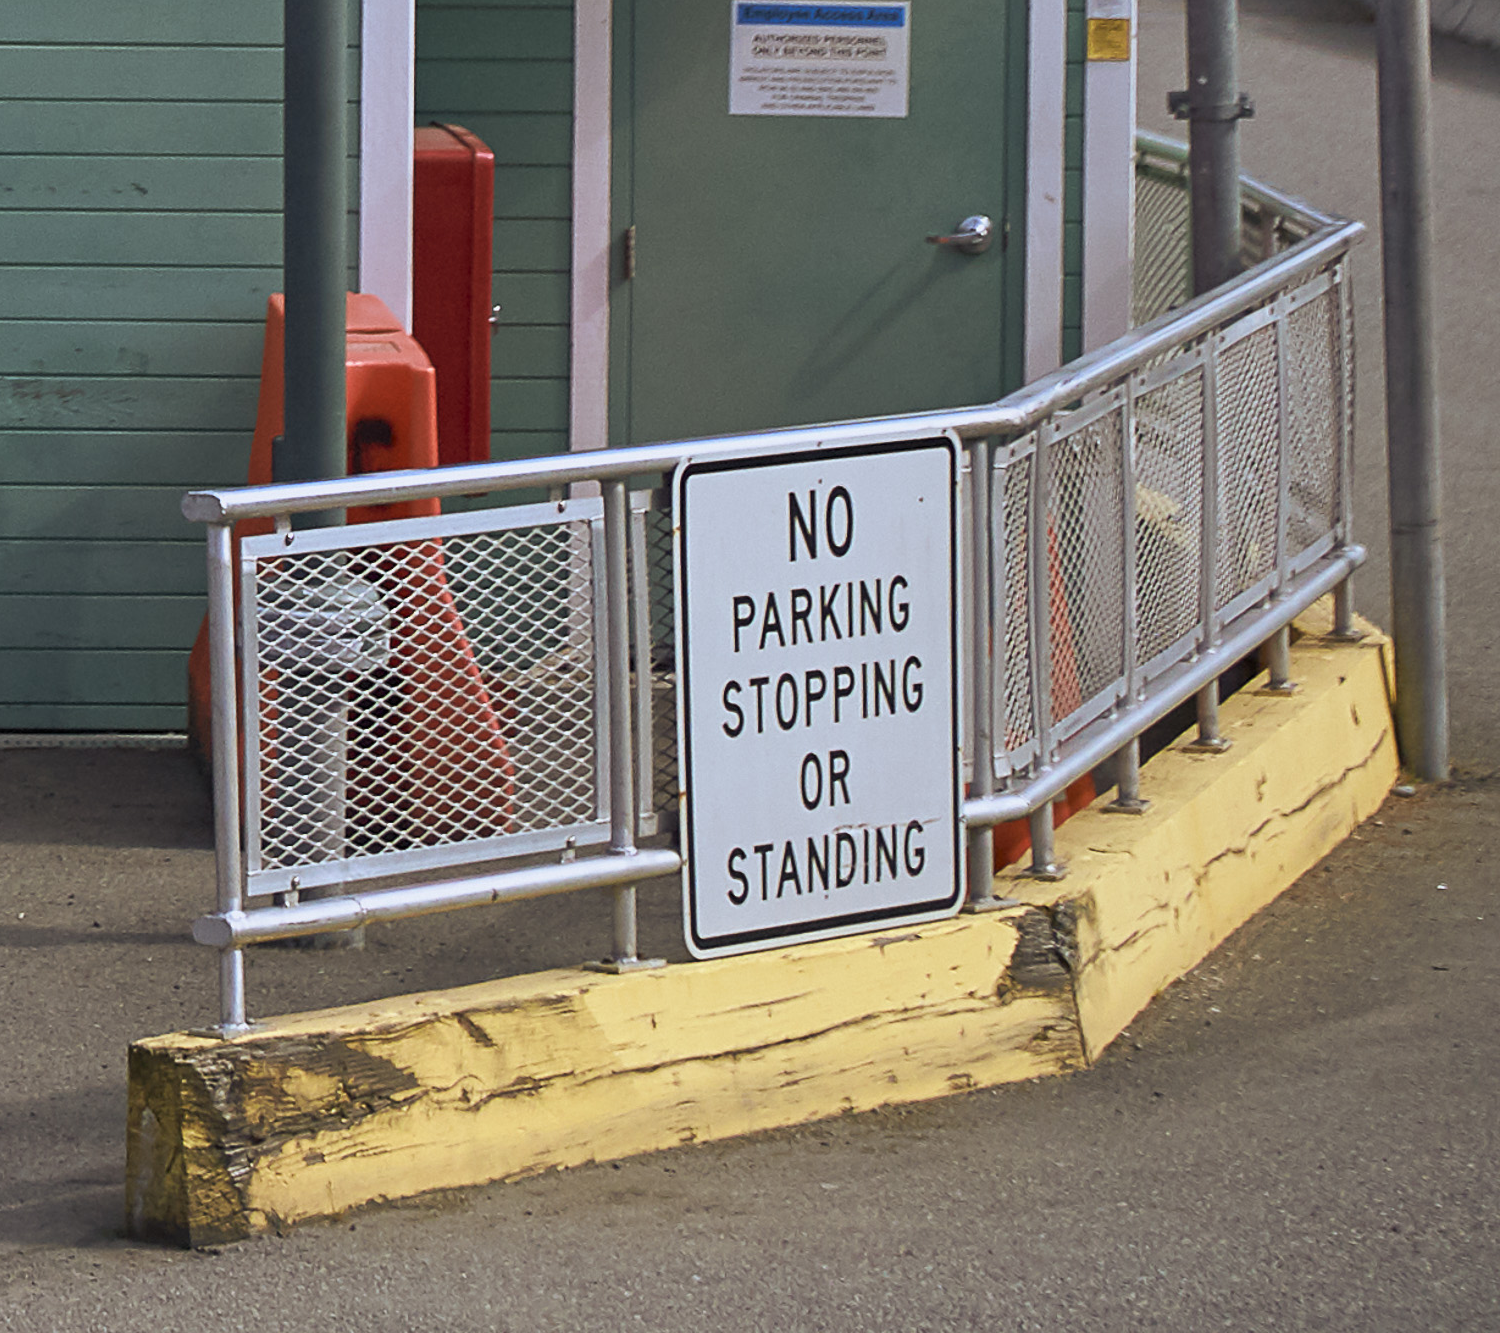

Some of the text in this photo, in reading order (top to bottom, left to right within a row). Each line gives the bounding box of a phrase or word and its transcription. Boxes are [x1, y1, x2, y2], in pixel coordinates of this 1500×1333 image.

[744, 5, 811, 23] Employee
[814, 7, 863, 22] Access
[787, 485, 854, 563] NO
[733, 574, 911, 653] PARKING
[722, 655, 925, 738] STOPPING
[800, 749, 852, 811] OR
[726, 819, 926, 905] STANDING
